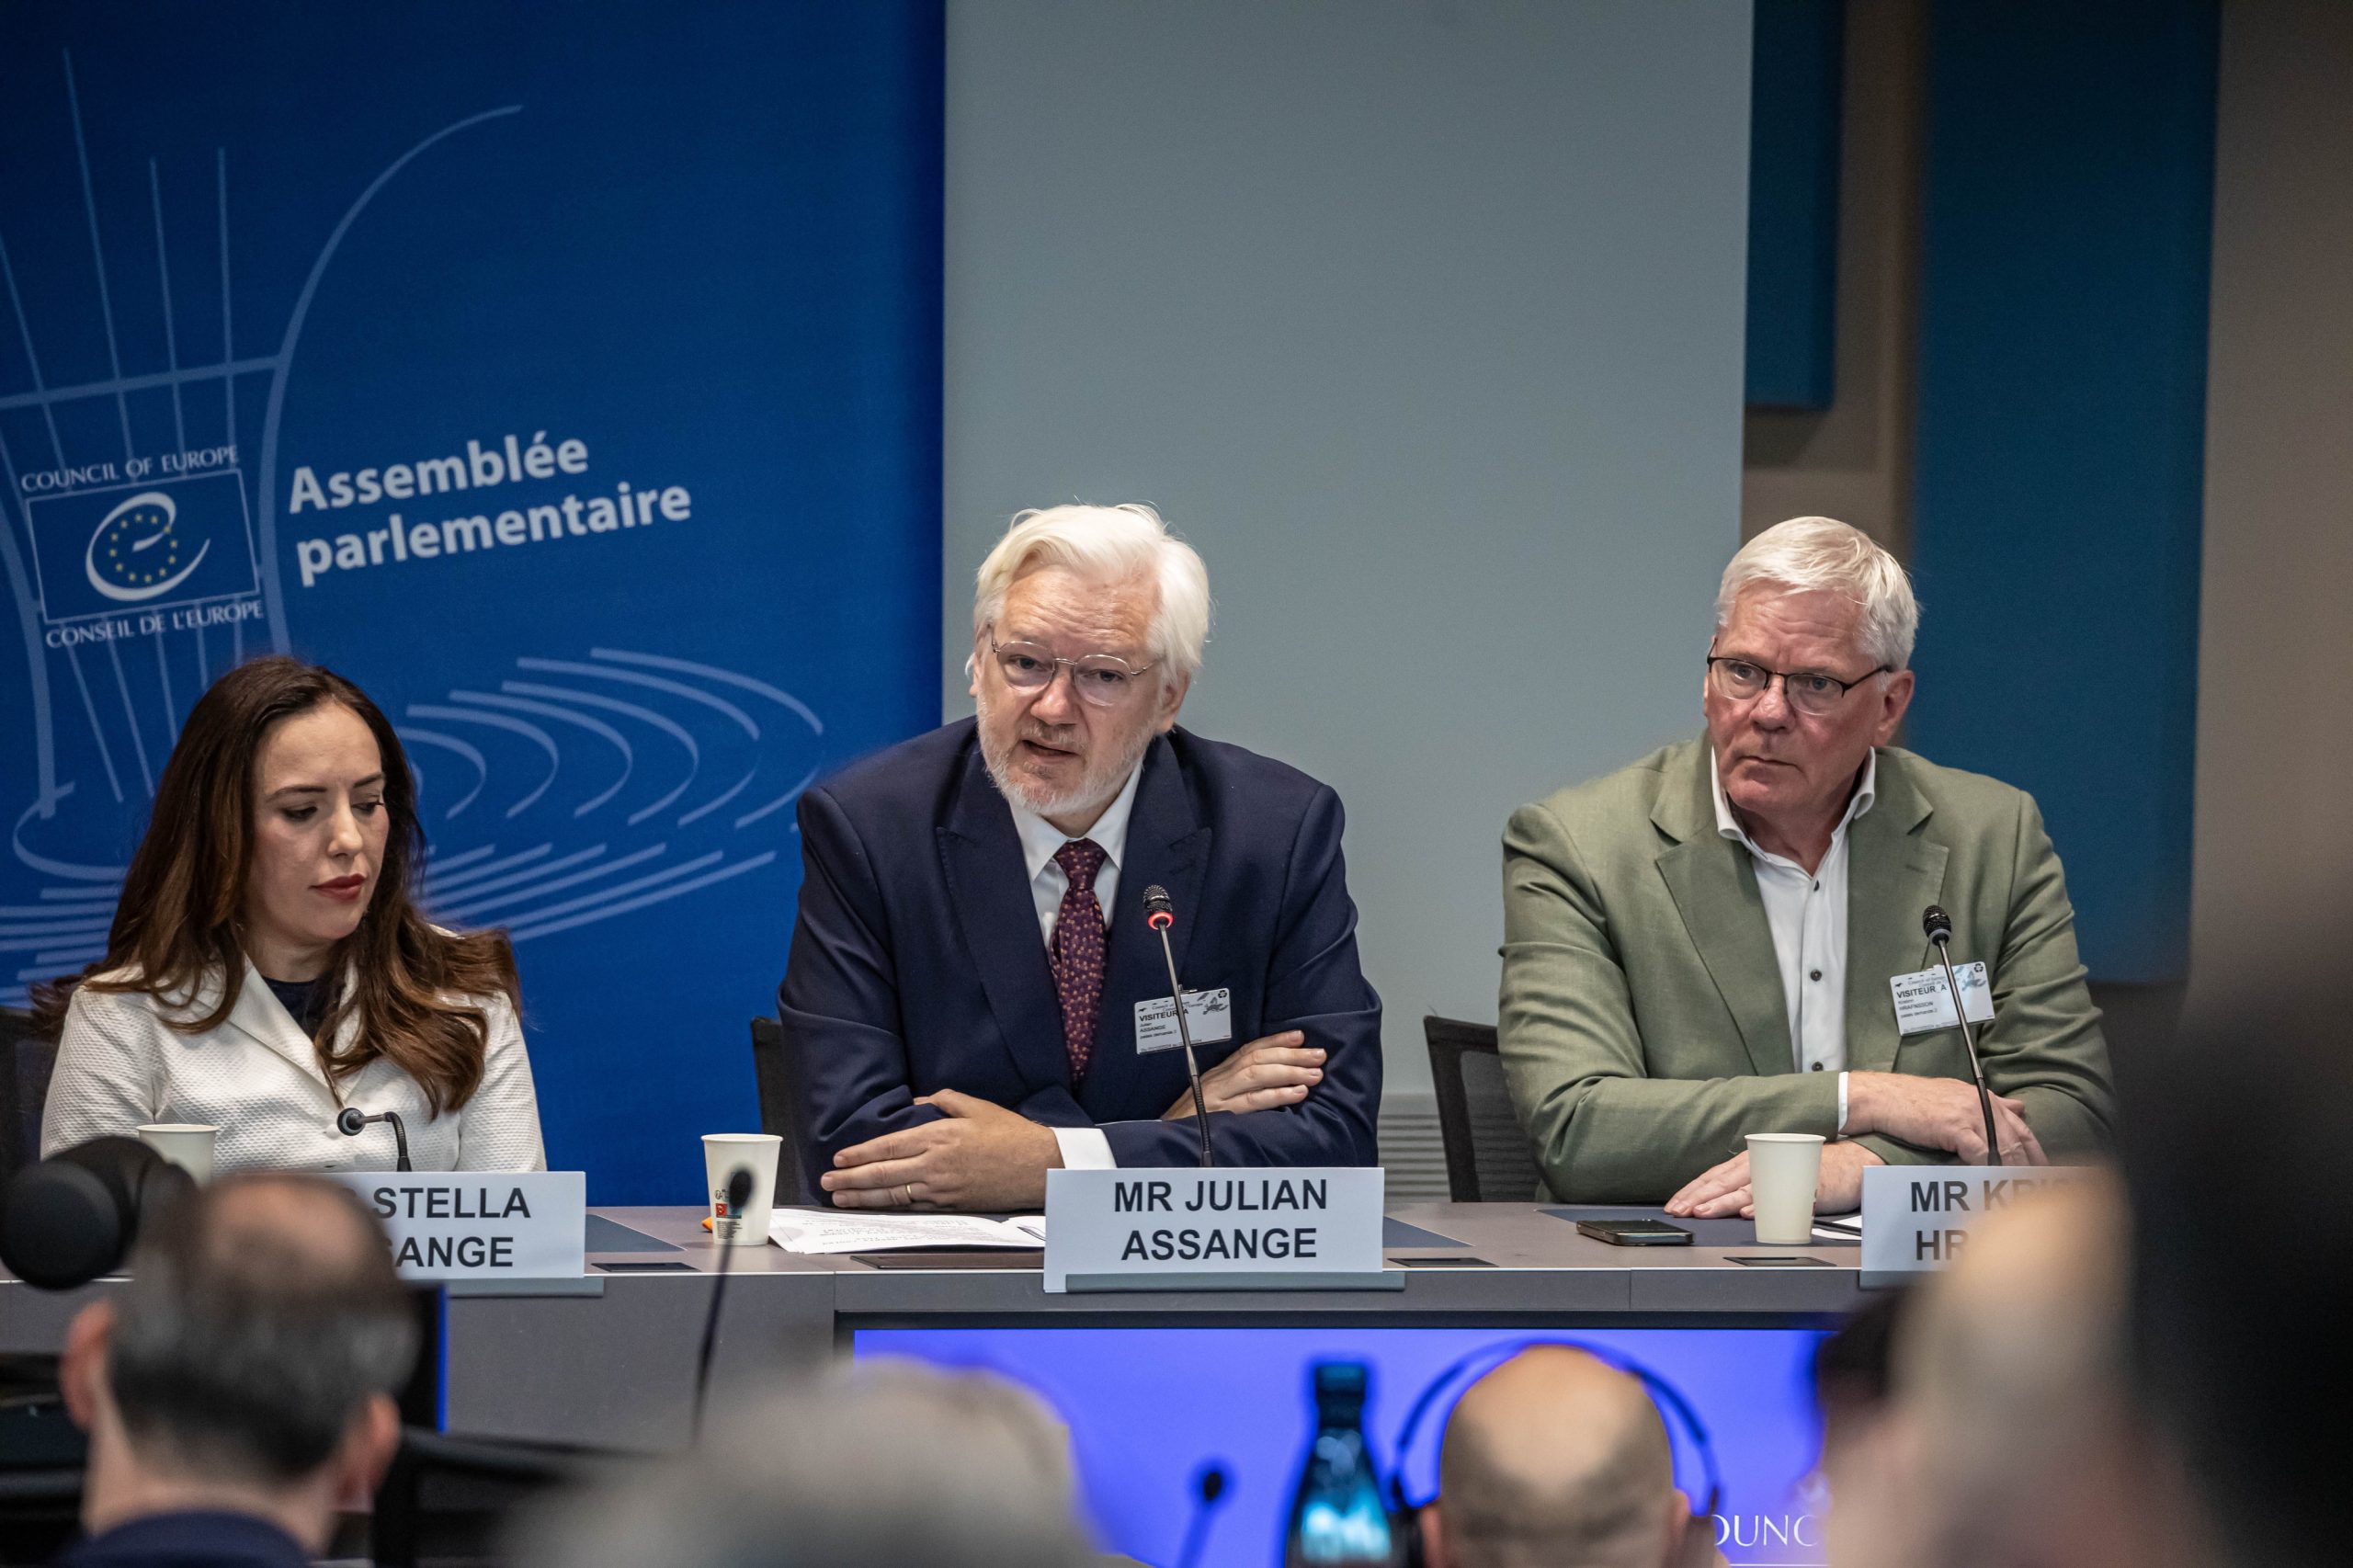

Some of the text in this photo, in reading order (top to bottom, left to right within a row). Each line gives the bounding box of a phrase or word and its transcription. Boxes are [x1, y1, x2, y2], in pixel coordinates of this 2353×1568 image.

[21, 445, 239, 492] COUNCIL OF EUROPE
[289, 430, 588, 514] Assemblée
[296, 482, 692, 588] parlementaire
[46, 599, 264, 649] CONSEIL DE L'EUROPE
[1896, 983, 1948, 999] VISITEUR A
[1139, 1010, 1178, 1022] VISITEUR
[372, 1187, 531, 1220] STELLA
[1114, 1178, 1327, 1212] MR JULIAN
[1911, 1180, 1971, 1212] MR
[386, 1236, 515, 1268] ANGE
[1120, 1227, 1317, 1261] ASSANGE
